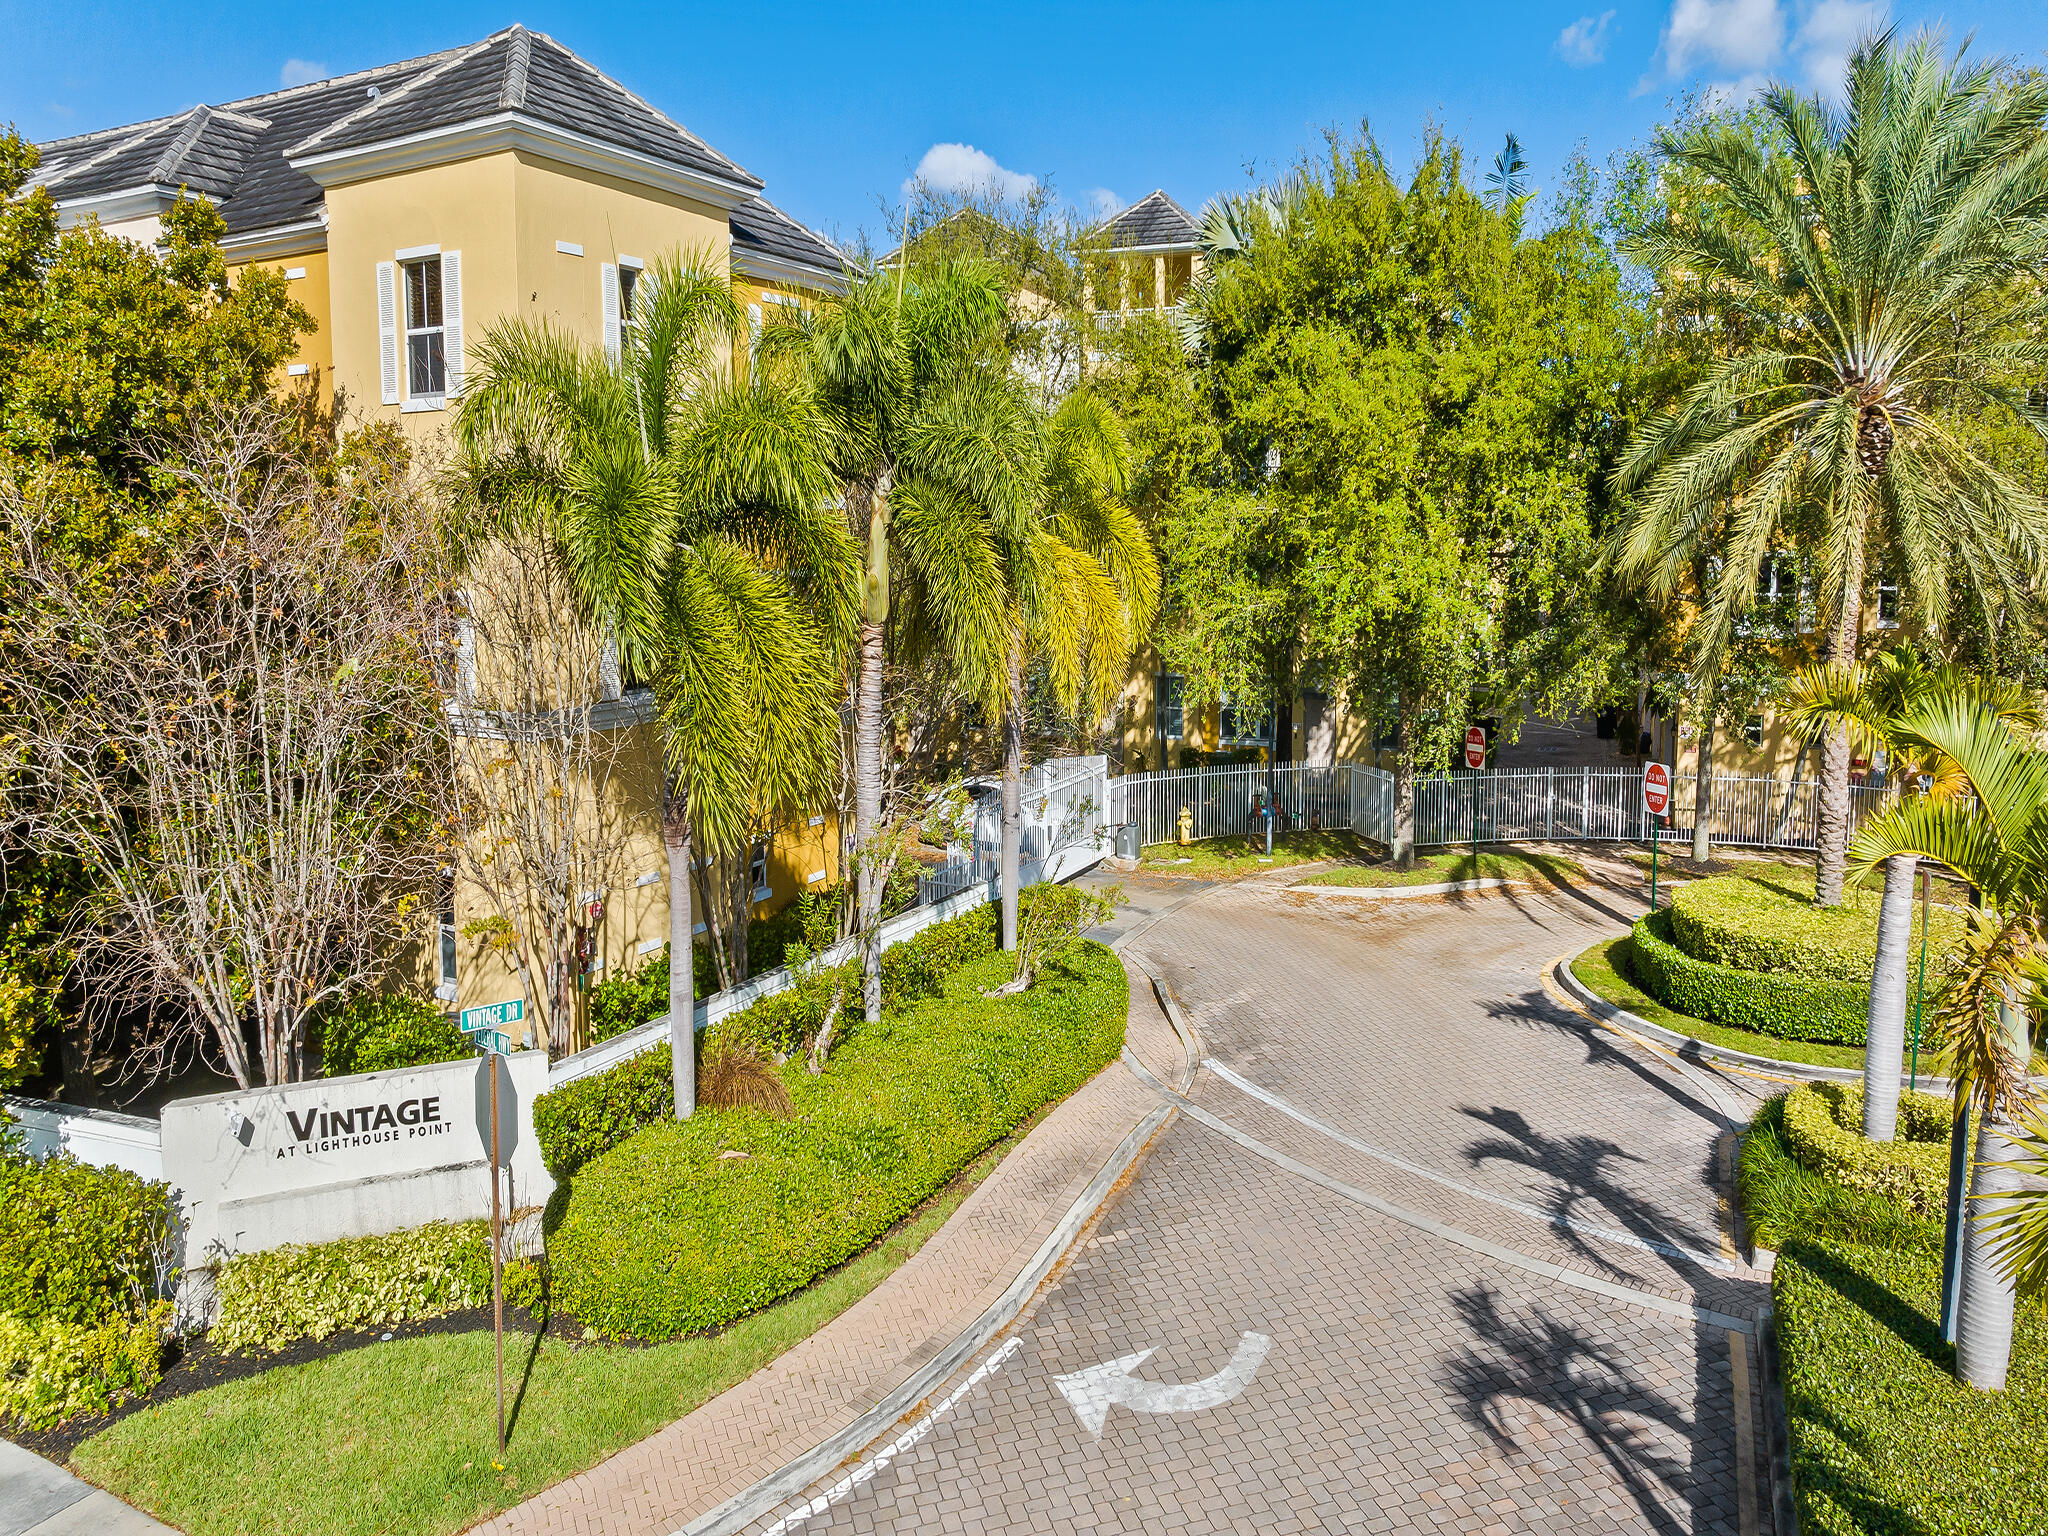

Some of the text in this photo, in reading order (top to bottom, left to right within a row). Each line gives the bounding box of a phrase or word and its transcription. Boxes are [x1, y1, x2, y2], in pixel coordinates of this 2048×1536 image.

[1648, 772, 1666, 784] DO NOT
[1649, 794, 1664, 805] ENTER
[467, 1003, 518, 1028] VINTAGE DR
[286, 1096, 441, 1142] VINTAGE
[276, 1121, 452, 1159] AT LIGHTHOUSE POINT
